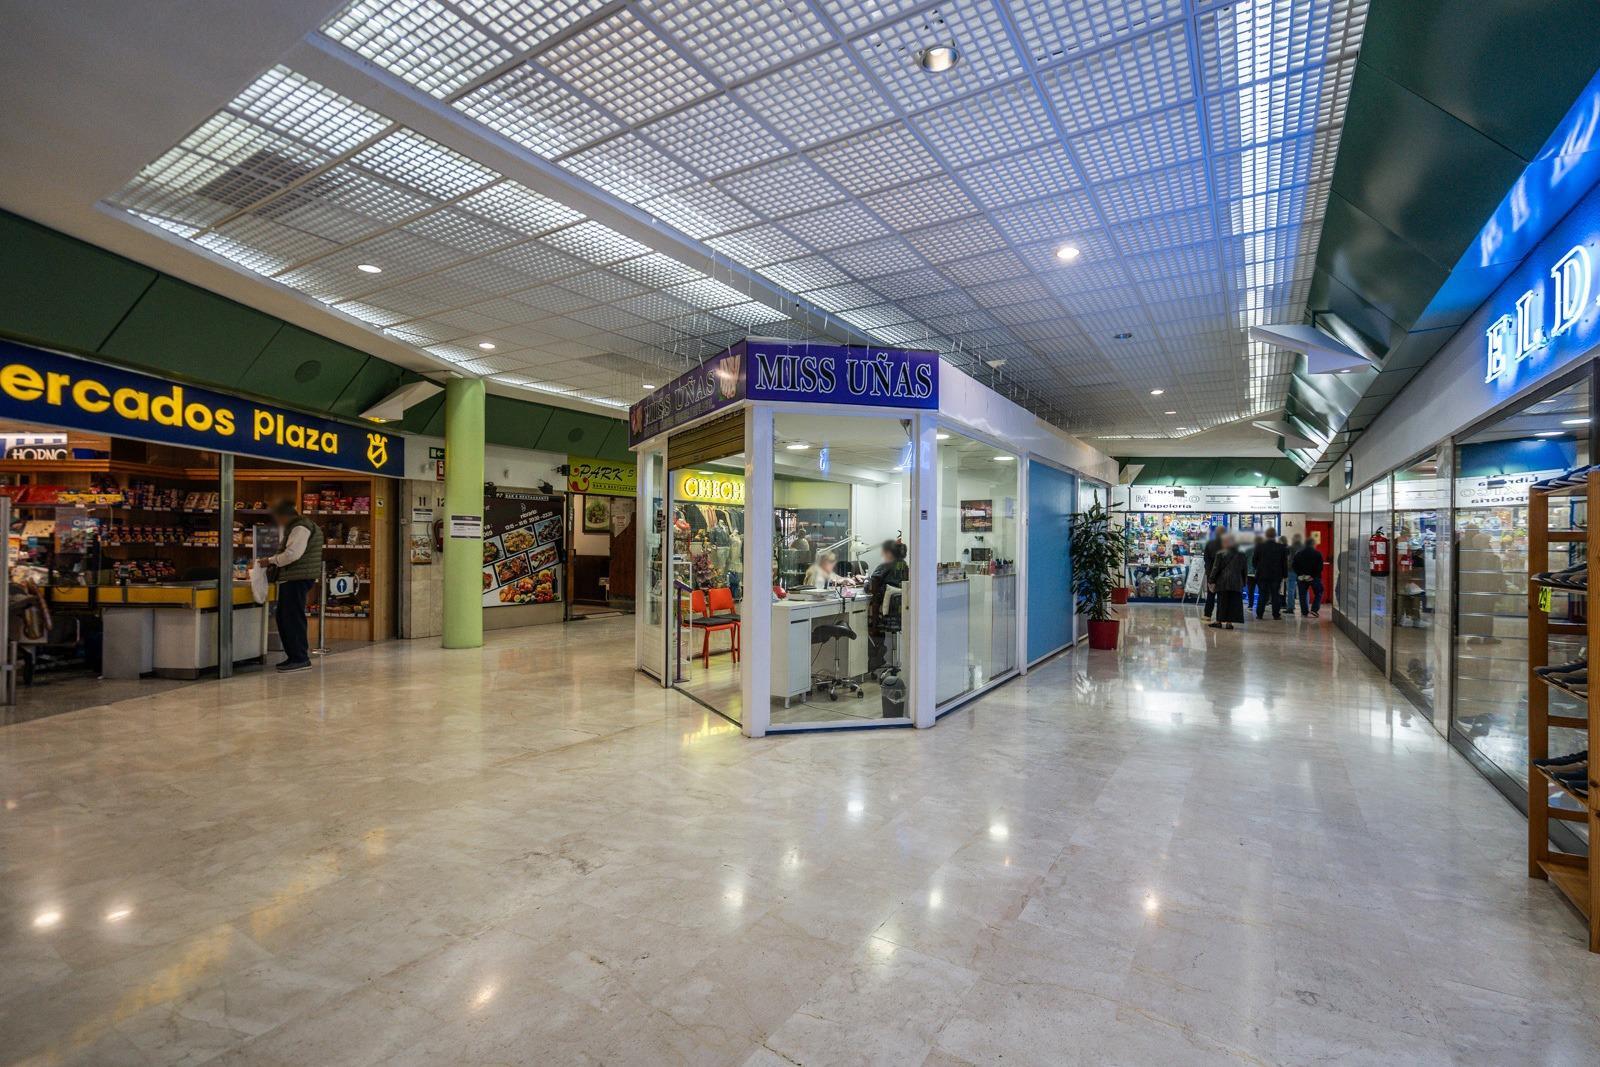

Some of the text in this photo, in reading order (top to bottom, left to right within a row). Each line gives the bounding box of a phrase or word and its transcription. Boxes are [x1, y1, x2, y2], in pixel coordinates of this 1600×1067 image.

[1485, 244, 1600, 384] ELD
[674, 369, 716, 411] UÑAS
[755, 352, 933, 399] MISS UÑAS
[0, 363, 236, 437] ercados
[419, 496, 426, 507] 11
